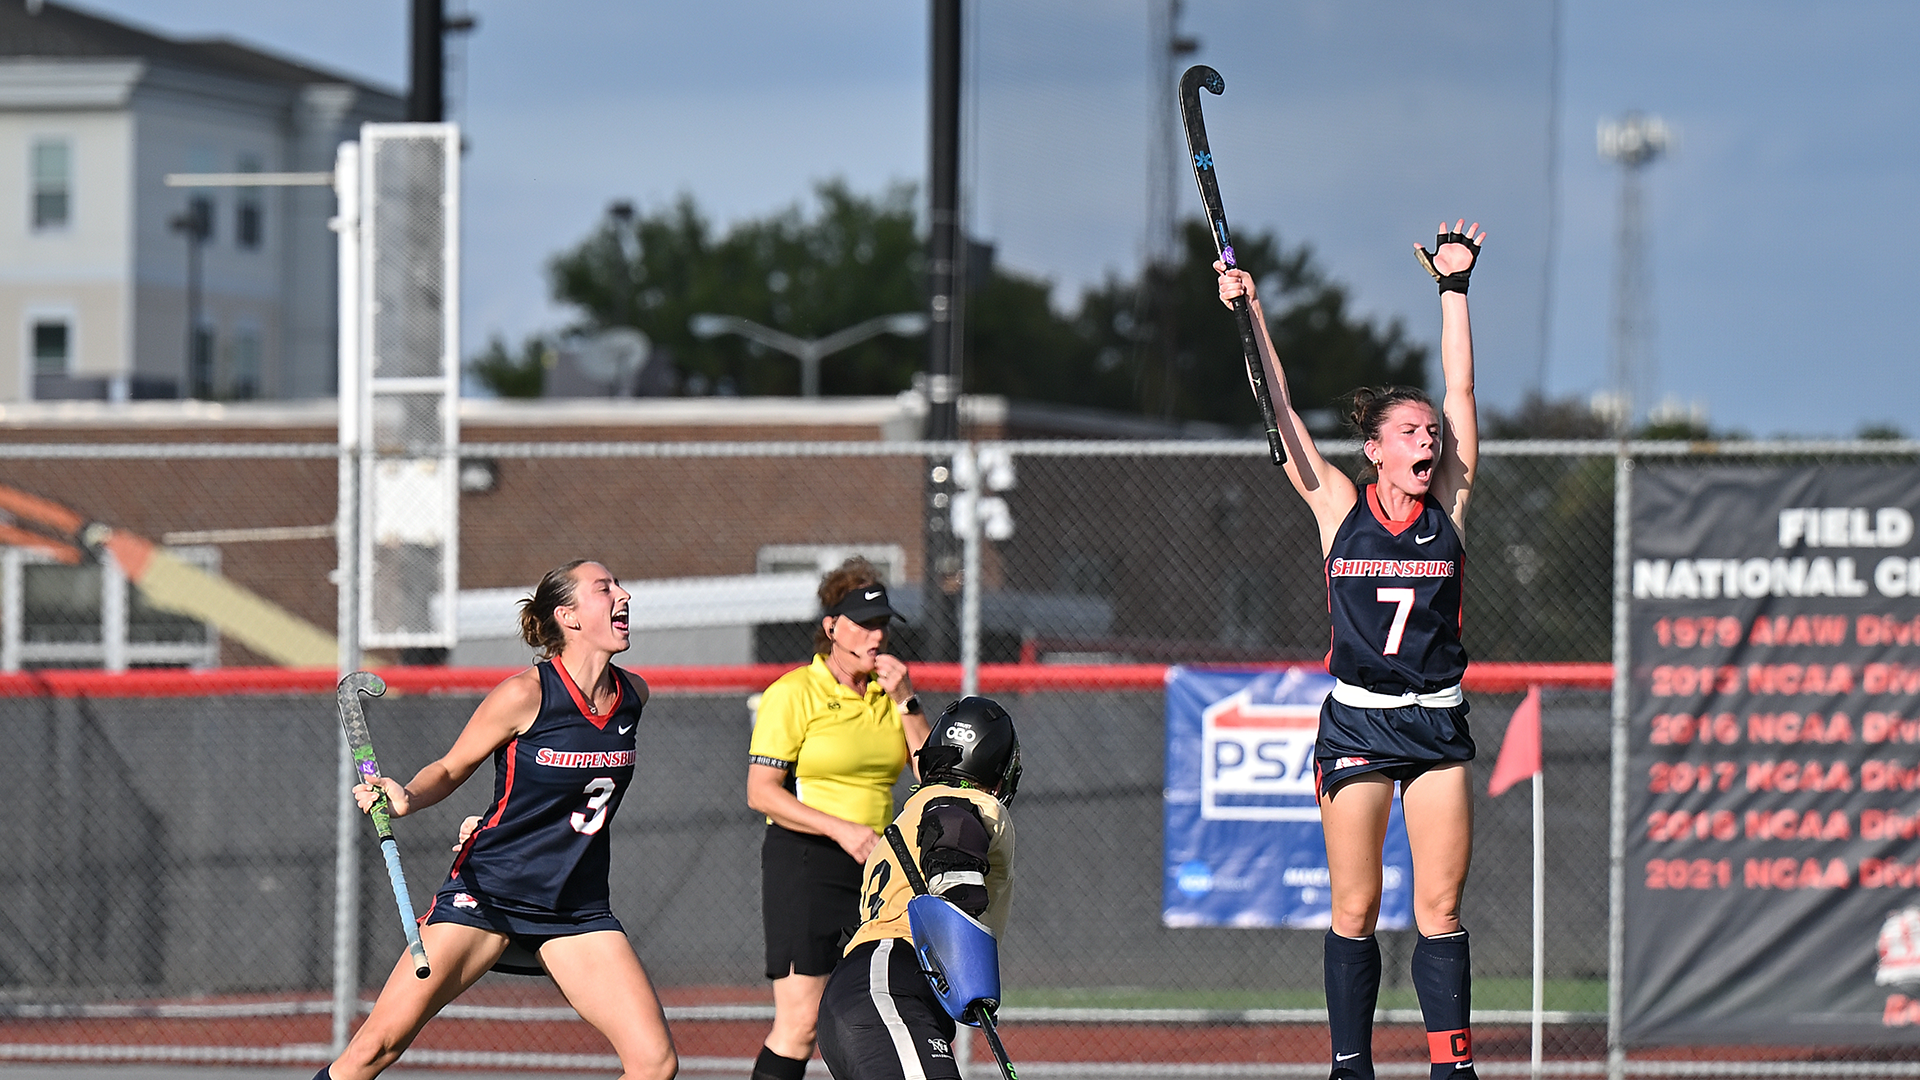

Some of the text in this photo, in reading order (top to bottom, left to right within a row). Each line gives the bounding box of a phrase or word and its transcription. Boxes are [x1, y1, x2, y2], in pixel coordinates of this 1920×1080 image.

[1779, 507, 1914, 549] FIELD
[1331, 557, 1455, 578] SHIPPENSBURG
[1633, 557, 1868, 599] NATIONAL
[1376, 587, 1415, 656] 7
[1653, 615, 1742, 648] 1979
[1749, 614, 1848, 647] AIAW
[1748, 662, 1853, 695] NCAA
[1747, 711, 1853, 744] NCAA
[1649, 761, 1737, 794] 2017
[1746, 760, 1853, 793] NCAA
[569, 777, 616, 835] 3
[1744, 809, 1850, 841] NCAA
[1645, 858, 1732, 890] 2021
[1744, 857, 1850, 890] NCAA
[1450, 1033, 1468, 1057] C
